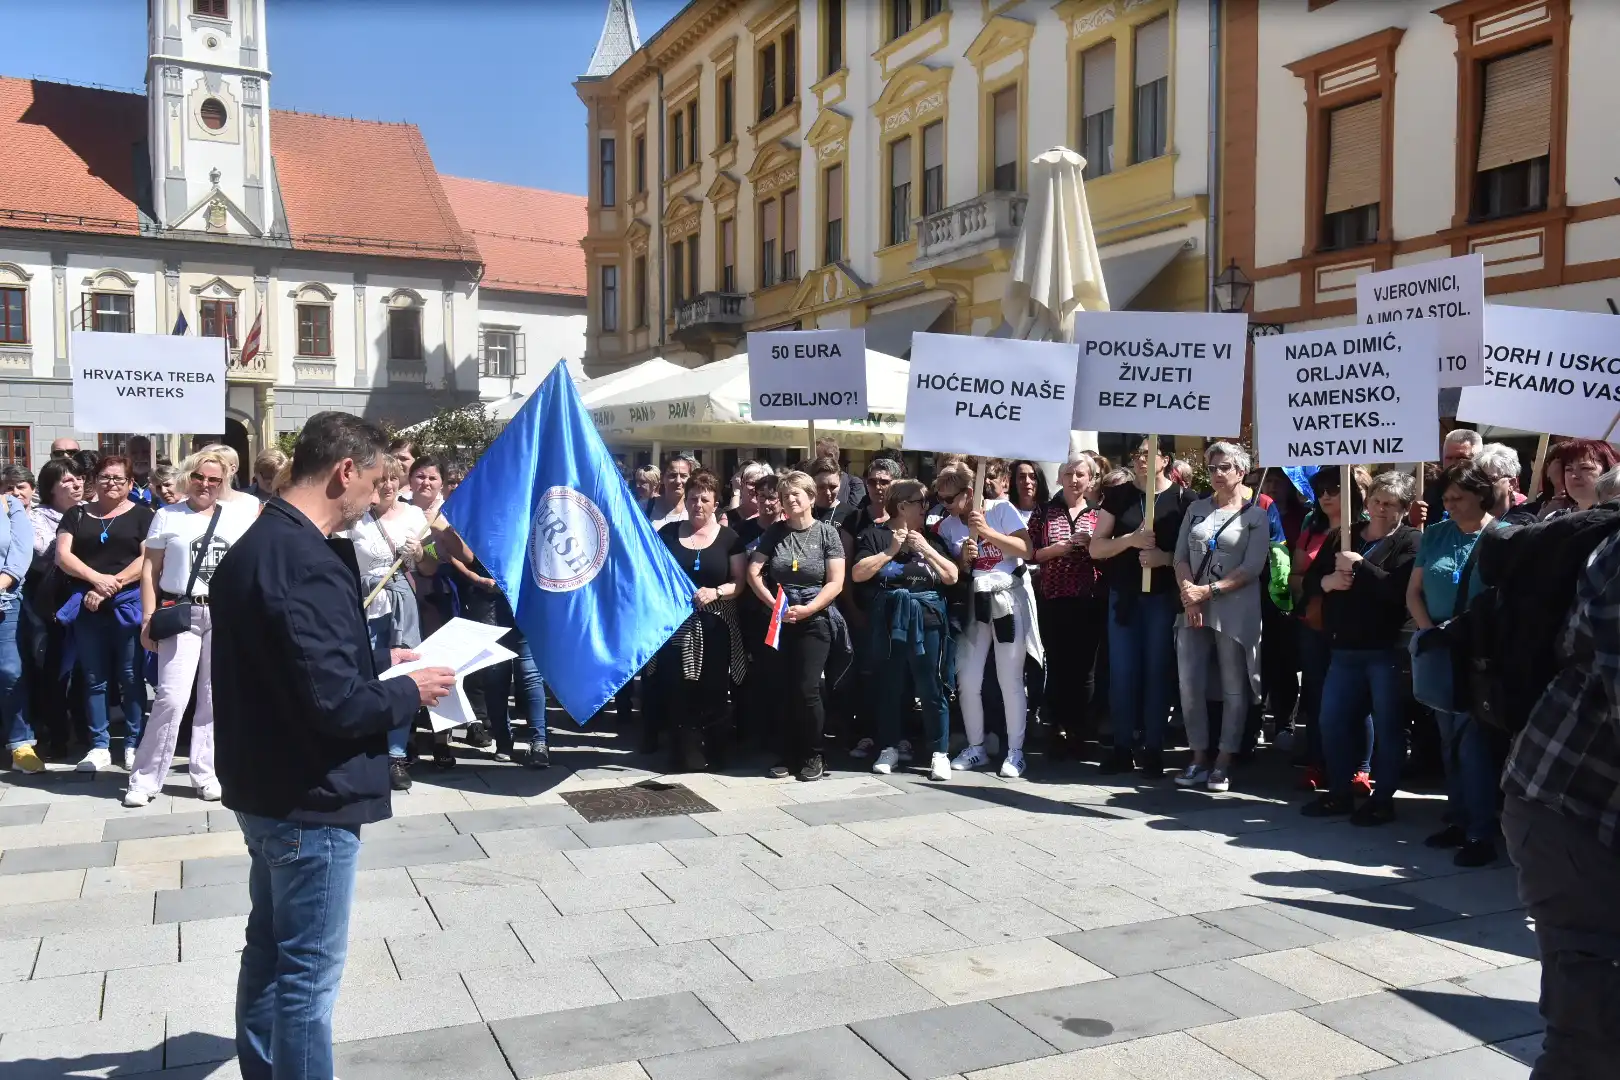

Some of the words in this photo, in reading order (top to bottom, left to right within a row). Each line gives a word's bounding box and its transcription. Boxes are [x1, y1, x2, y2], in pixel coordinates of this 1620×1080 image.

[1374, 275, 1460, 301] VJEROVNICI,
[1428, 302, 1470, 319] STOL.
[772, 345, 789, 359] 50
[795, 343, 841, 359] EURA
[1085, 338, 1206, 359] POKUŠAJTE
[1212, 343, 1232, 359] VI
[1285, 341, 1337, 361] NADA
[1343, 331, 1401, 355] DIMIĆ,
[1446, 355, 1467, 372] TO
[1546, 351, 1553, 367] I
[83, 368, 163, 382] HRVATSKA
[168, 372, 215, 383] TREBA
[1118, 362, 1192, 383] ŽIVJETI
[1296, 361, 1389, 383] ORLJAVA,
[116, 386, 184, 398] VARTEKS
[917, 373, 1005, 395] HOĆEMO
[1011, 379, 1066, 401] NAŠE
[1288, 385, 1400, 408] KAMENSKO,
[759, 391, 858, 407] OZBILJNO?!
[1099, 391, 1137, 407] BEZ
[1143, 391, 1211, 410] PLAĆE
[630, 407, 648, 421] PAN
[668, 402, 690, 419] PAN
[955, 401, 1022, 421] PLAĆE
[1292, 411, 1396, 431] VARTEKS...
[1288, 439, 1367, 457] NASTAVI
[1373, 438, 1404, 454] NIZ
